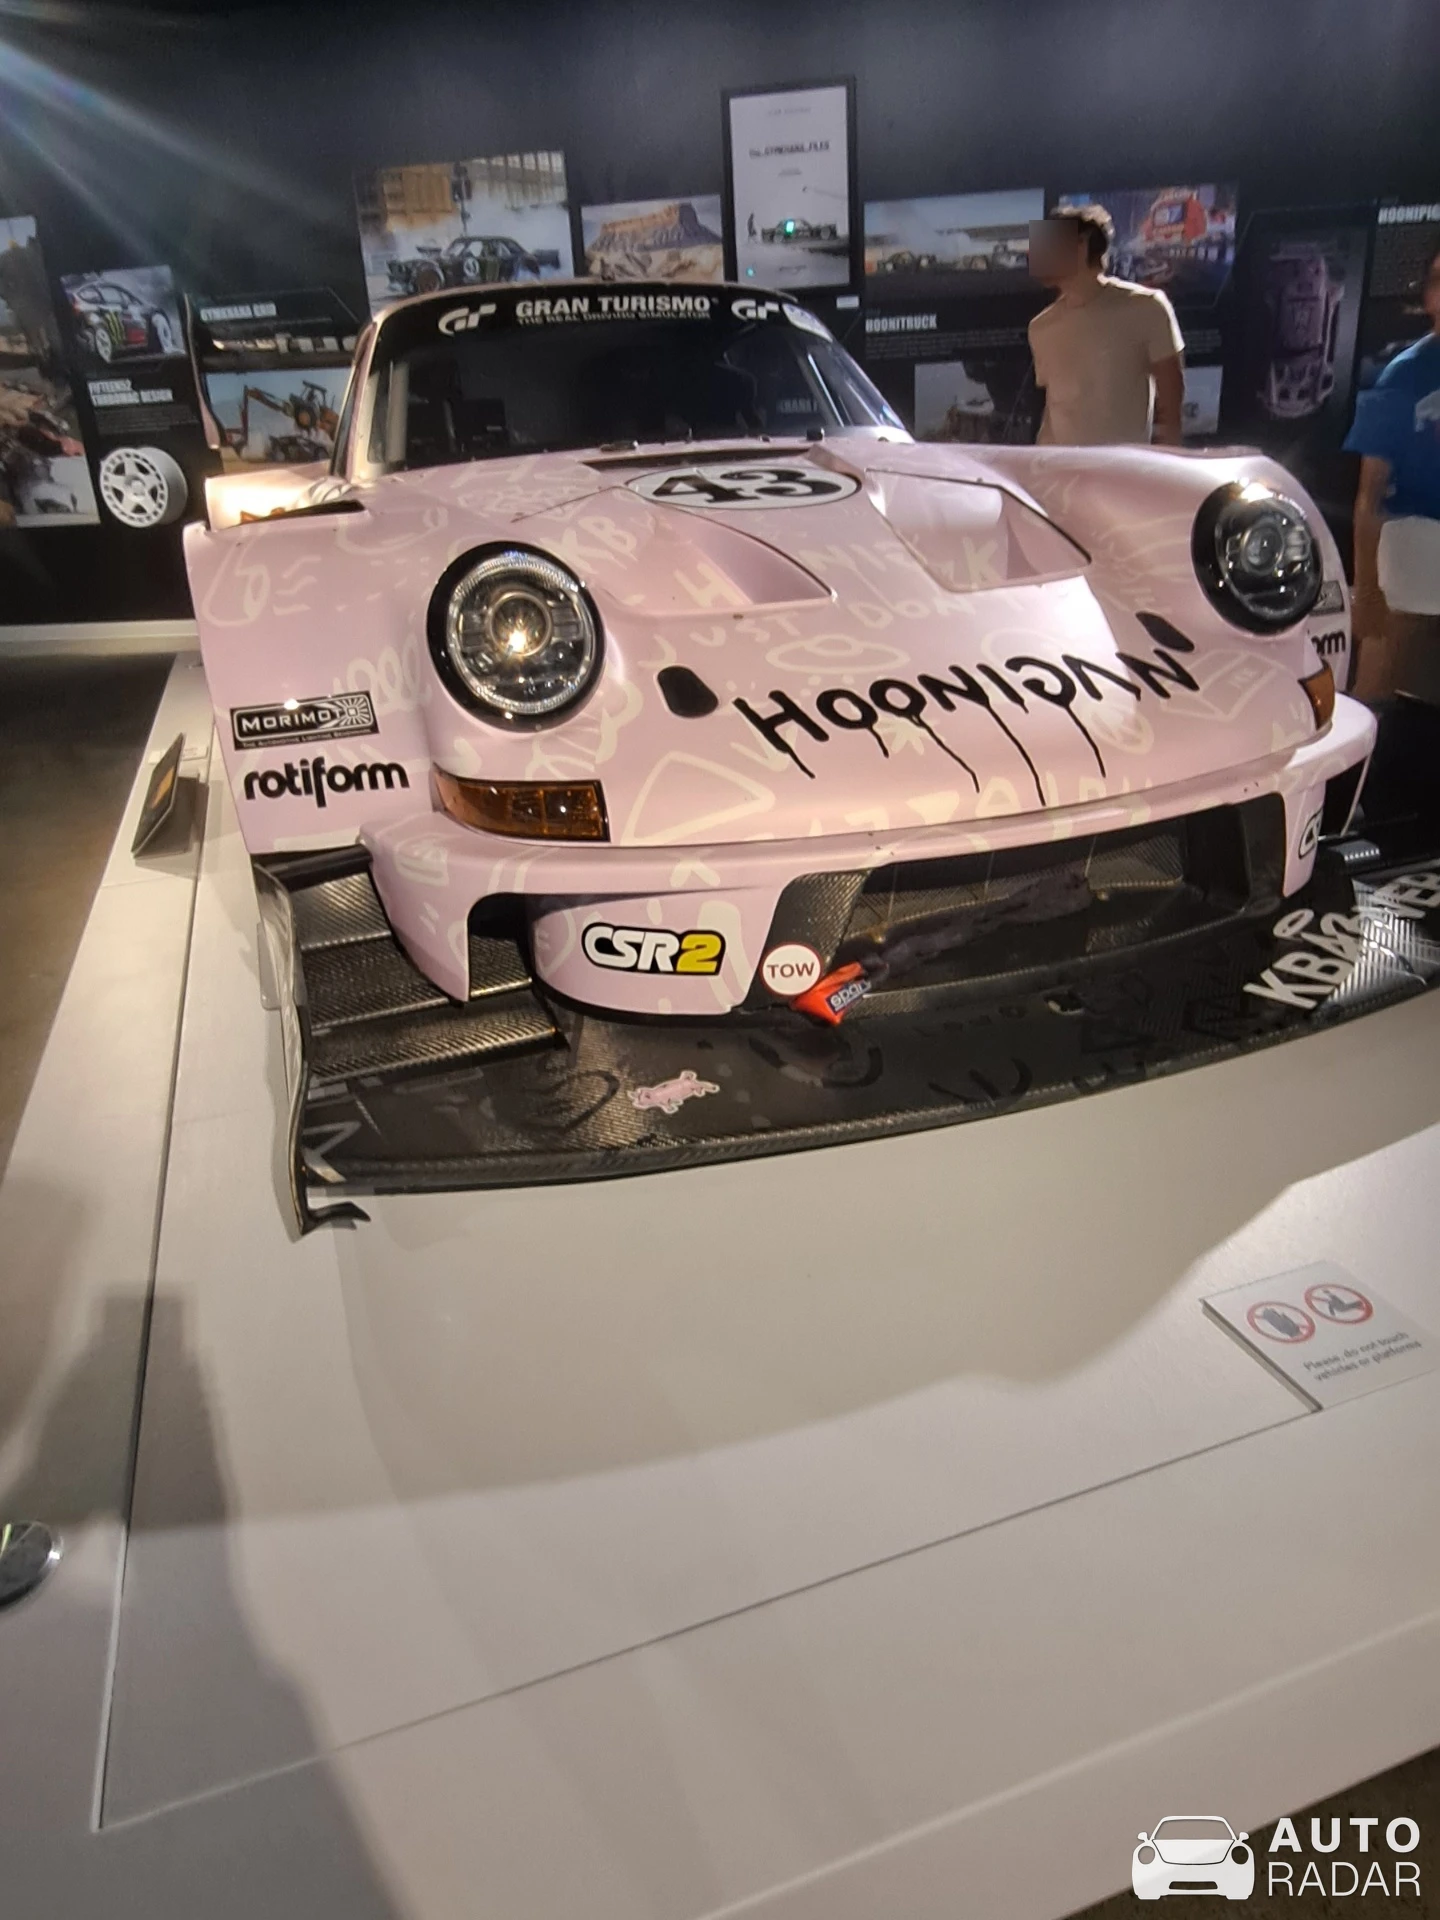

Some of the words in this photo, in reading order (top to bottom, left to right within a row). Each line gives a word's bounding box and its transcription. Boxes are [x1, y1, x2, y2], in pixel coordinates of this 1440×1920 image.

[516, 297, 590, 317] GRAN
[546, 314, 579, 324] REAL
[865, 313, 938, 333] HOONITRUCK
[652, 468, 842, 504] 43
[244, 756, 410, 808] rotiform
[584, 925, 723, 974] CSR2
[766, 962, 816, 979] TOW
